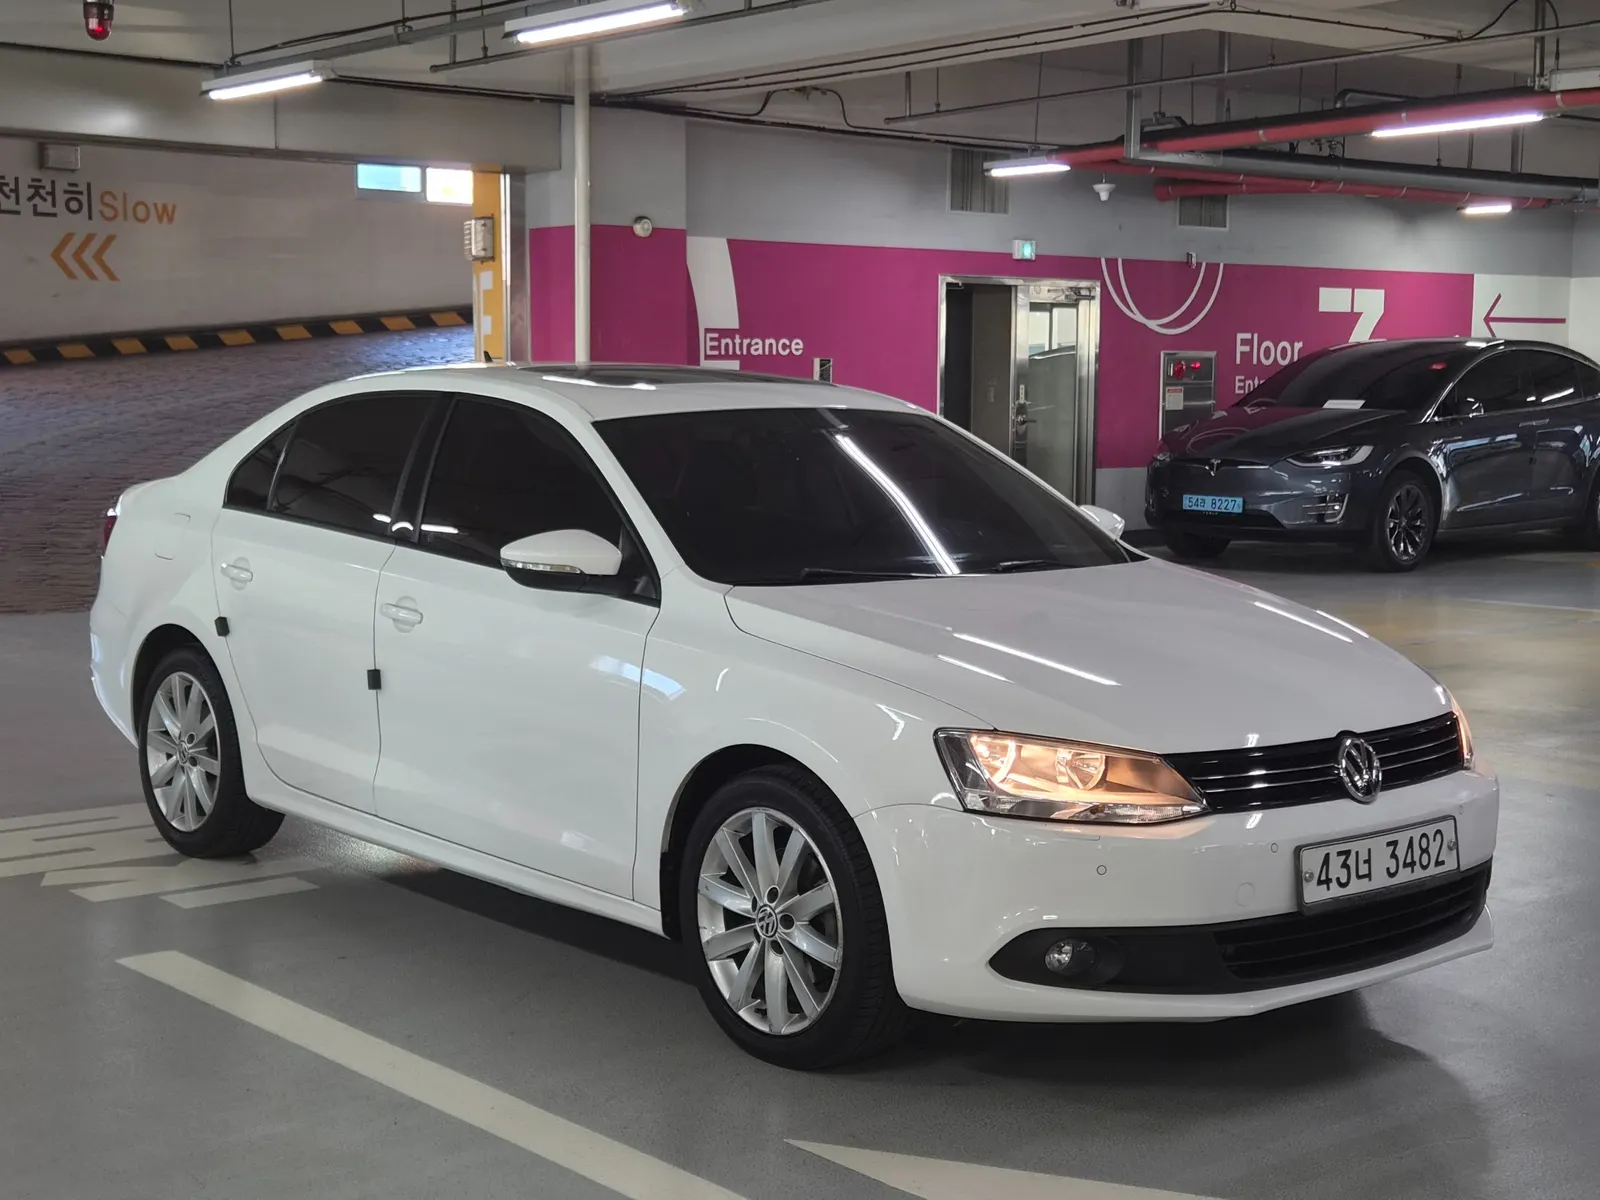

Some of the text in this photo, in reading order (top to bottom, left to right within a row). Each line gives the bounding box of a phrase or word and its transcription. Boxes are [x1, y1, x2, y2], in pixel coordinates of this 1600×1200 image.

[99, 191, 177, 224] Slow
[706, 333, 804, 356] Entrance
[1236, 333, 1303, 365] Floor
[1211, 498, 1237, 511] 8227
[1316, 829, 1446, 891] 43너 3482
